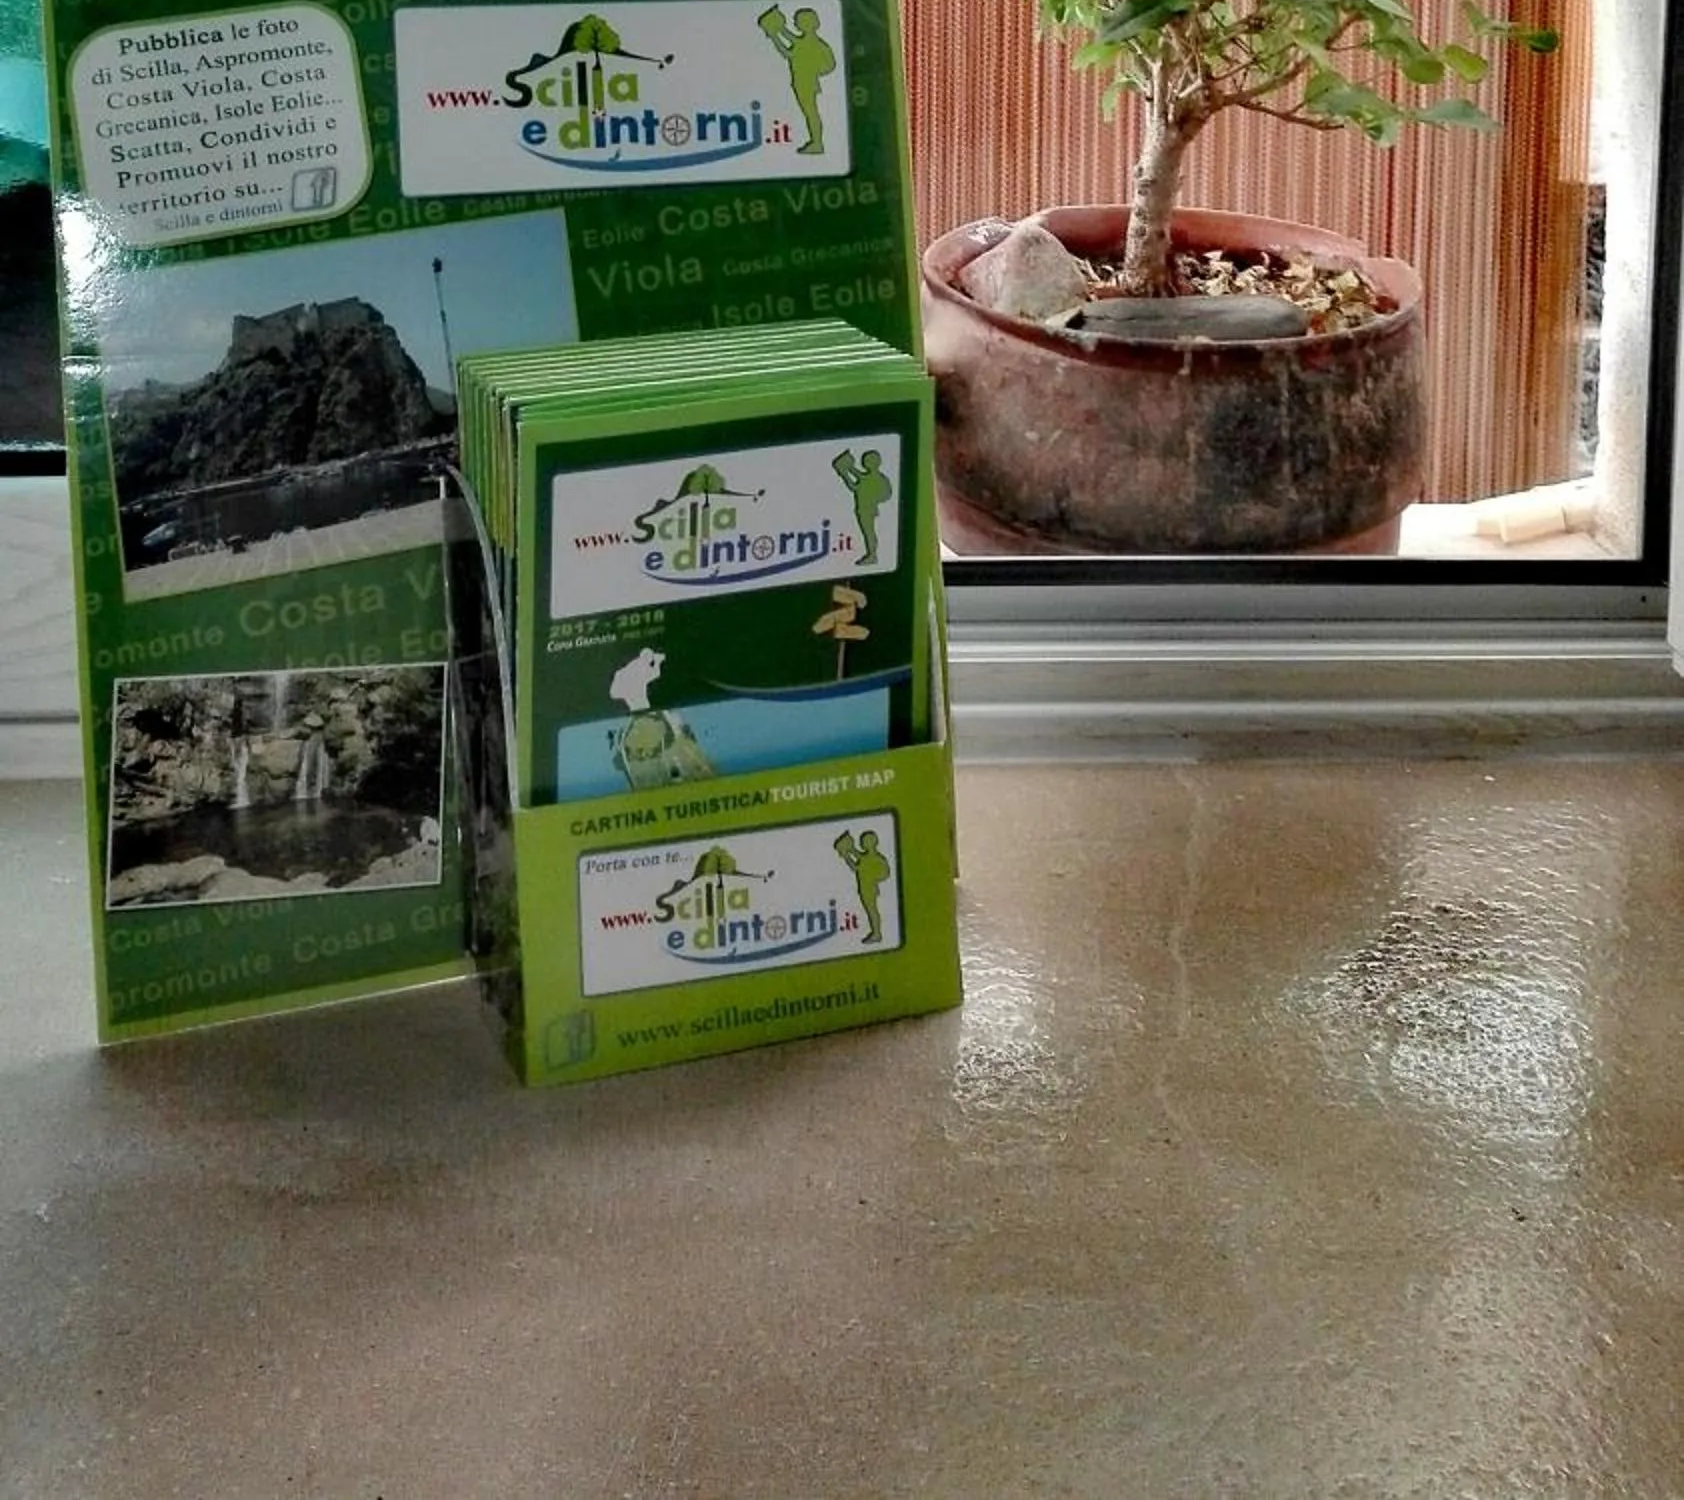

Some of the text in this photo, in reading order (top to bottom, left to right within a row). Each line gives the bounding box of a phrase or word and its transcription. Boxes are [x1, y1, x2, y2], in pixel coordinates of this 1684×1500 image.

[118, 18, 299, 56] Pubblica le foto
[91, 39, 334, 87] di Scilla, Aspromonte,
[106, 66, 327, 111] Costa Viola, Costa
[95, 109, 209, 140] Grecanica,
[216, 98, 265, 122] Isole
[110, 116, 338, 164] Scatta, Condividi e
[117, 142, 339, 190] Promuovi il nostro
[656, 197, 770, 237] Costa
[783, 178, 880, 216] Viola
[585, 251, 705, 300] Viola
[238, 582, 387, 638] Costa
[569, 807, 658, 838] CARTINA
[855, 768, 896, 790] MAP
[631, 853, 662, 869] con
[107, 913, 203, 956] Costa
[292, 917, 397, 965] Costa
